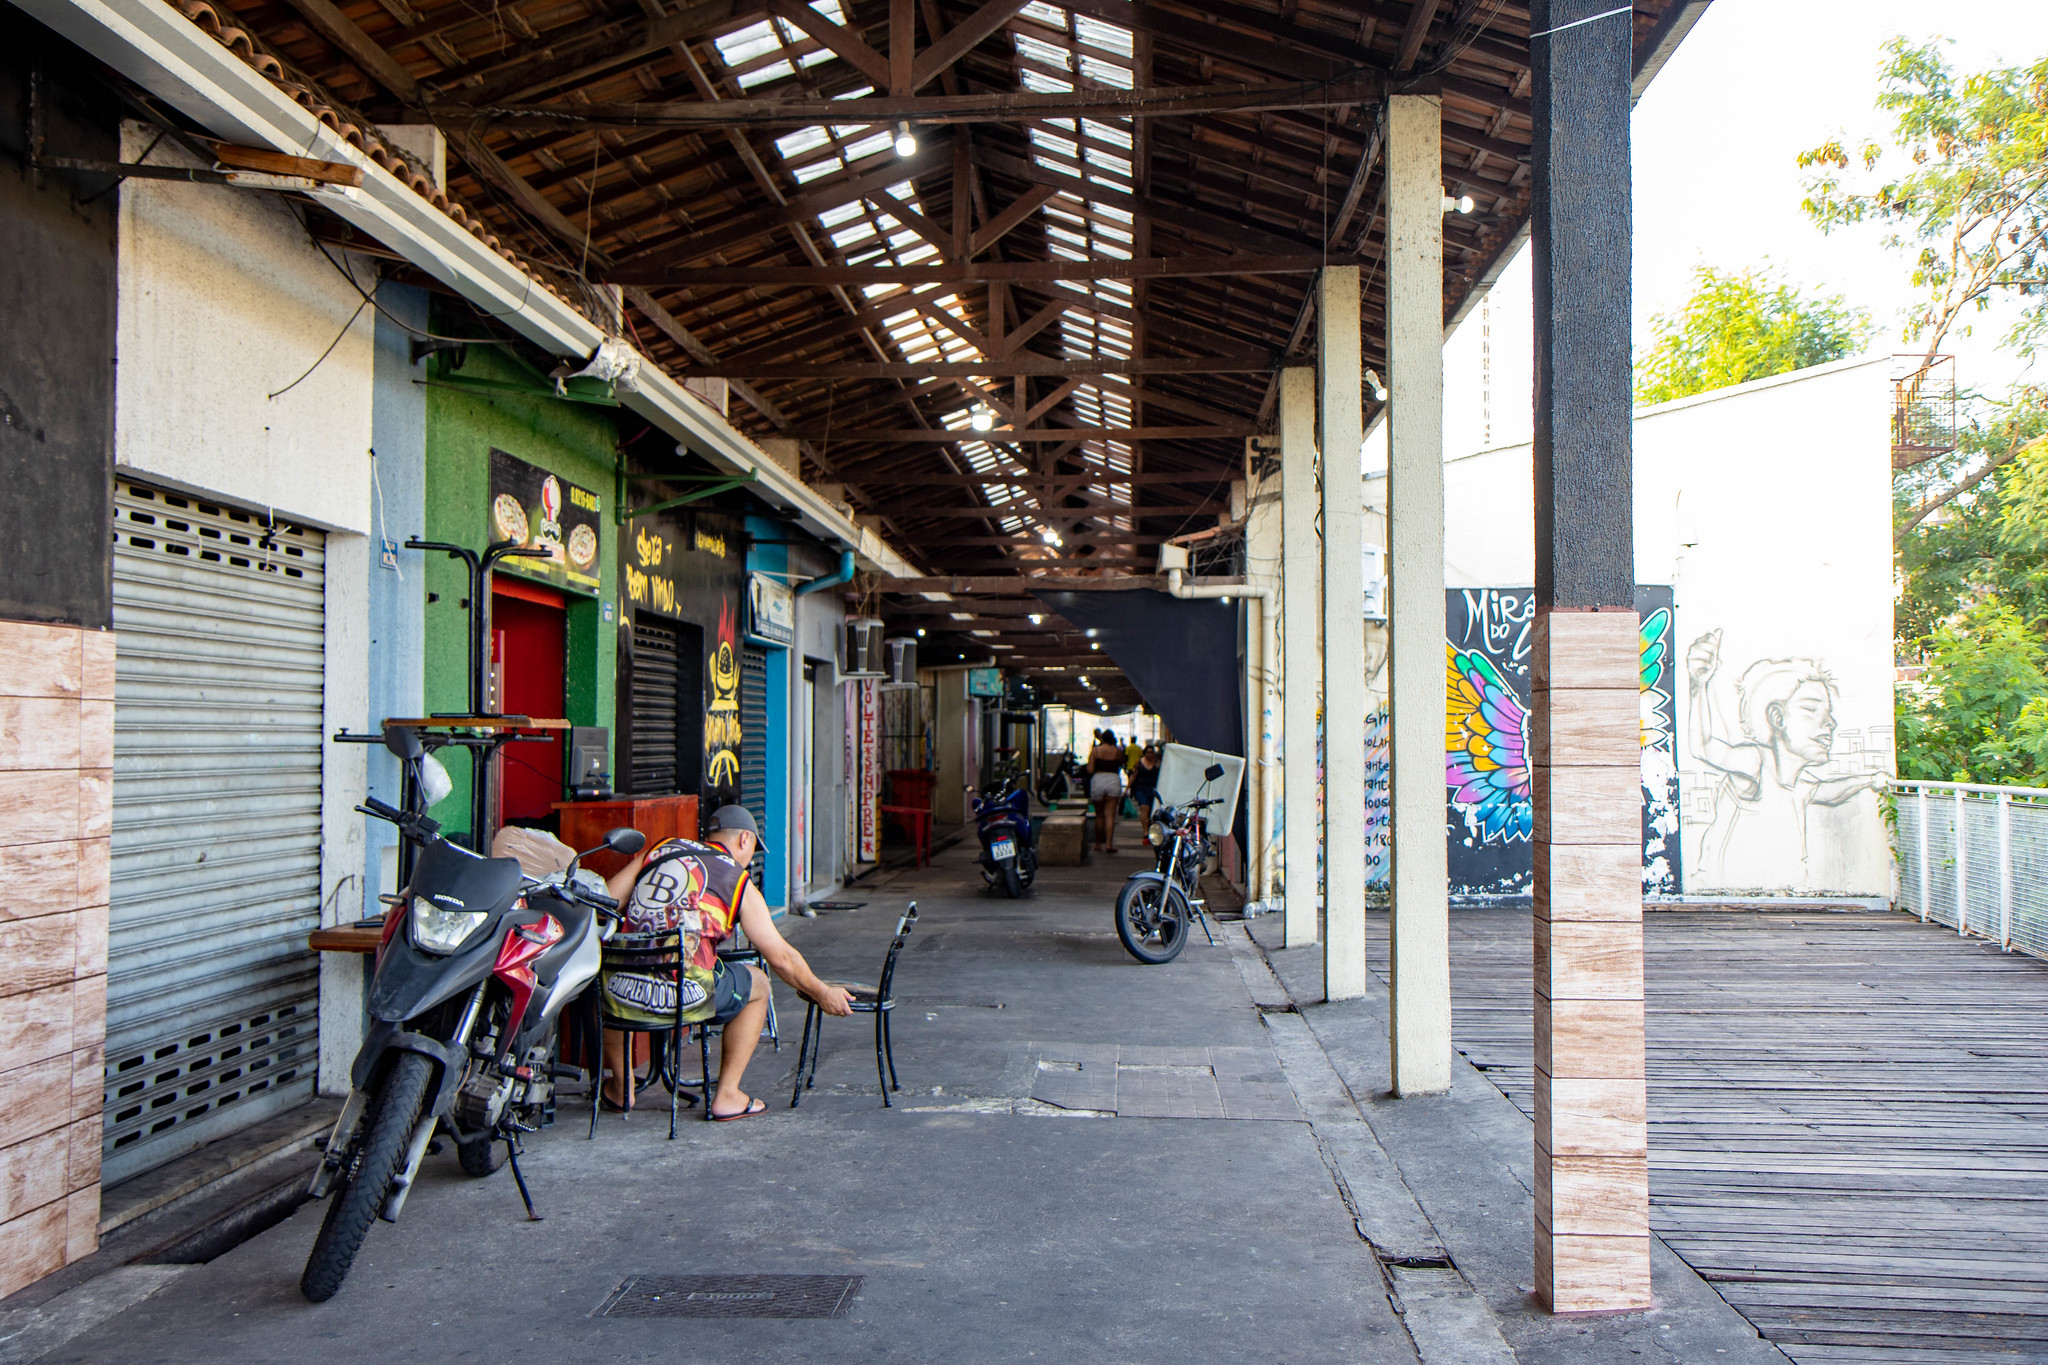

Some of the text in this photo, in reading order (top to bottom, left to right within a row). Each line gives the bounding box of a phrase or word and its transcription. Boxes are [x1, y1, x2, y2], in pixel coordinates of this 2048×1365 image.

[433, 893, 465, 907] HONDA
[607, 975, 706, 1008] COMPLEXO DO ALMÃO
